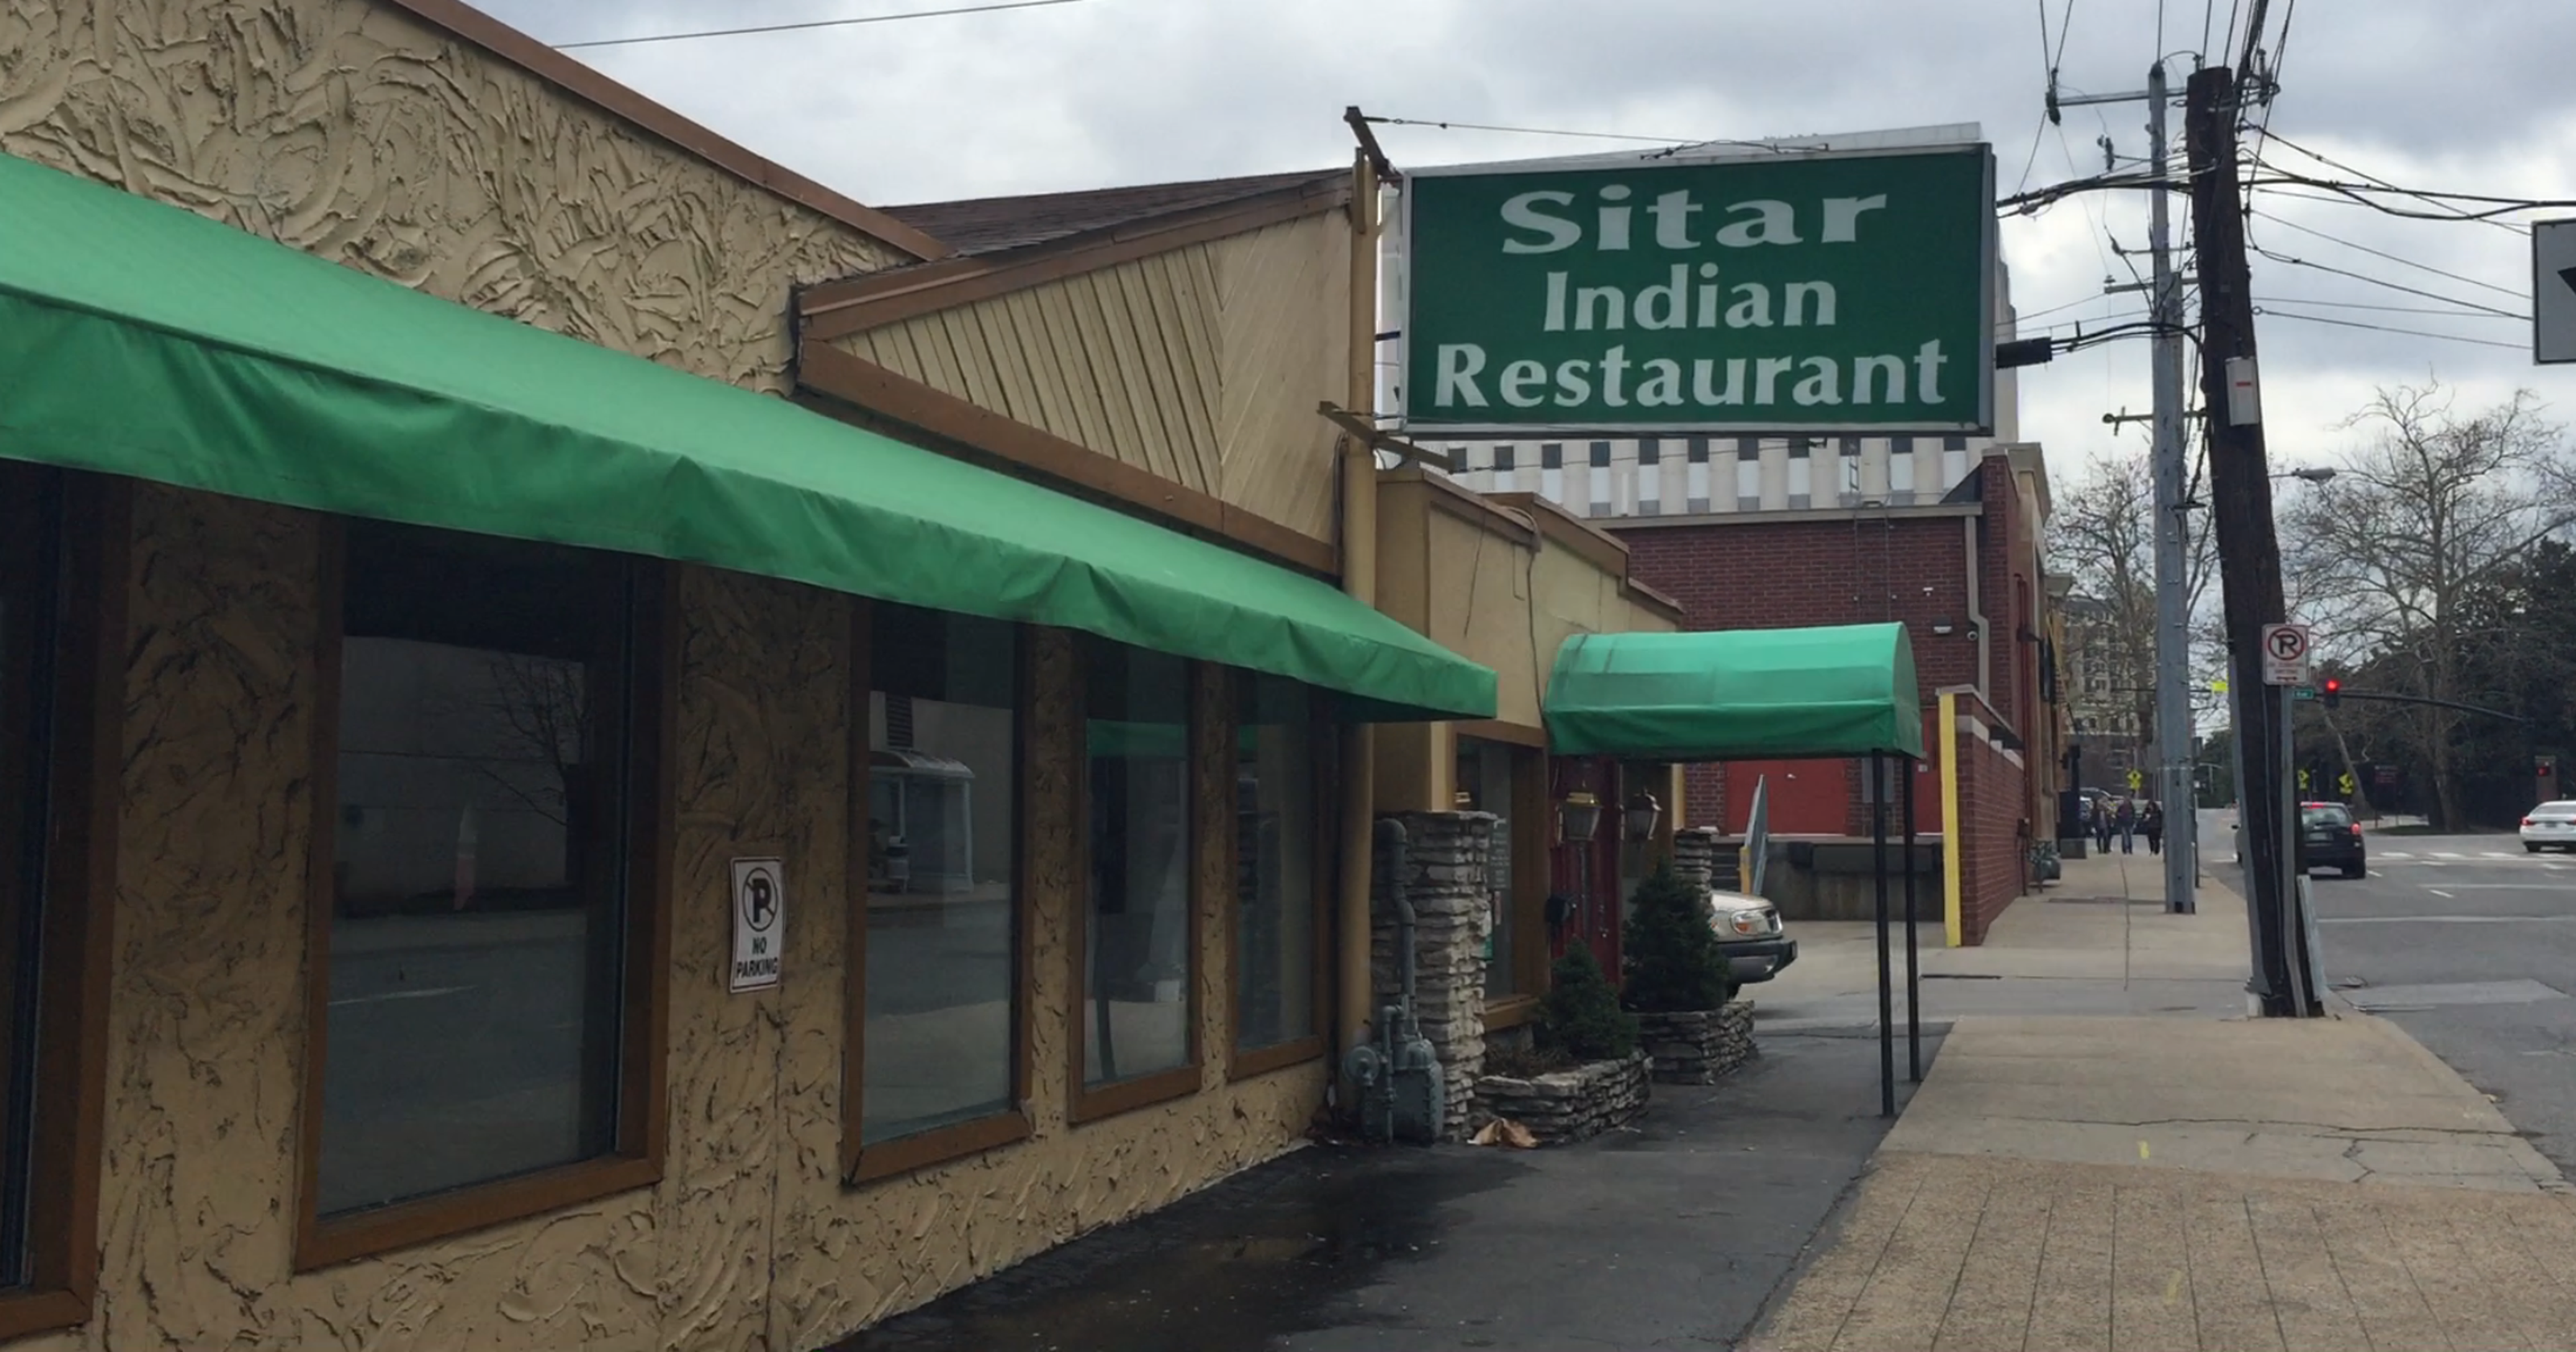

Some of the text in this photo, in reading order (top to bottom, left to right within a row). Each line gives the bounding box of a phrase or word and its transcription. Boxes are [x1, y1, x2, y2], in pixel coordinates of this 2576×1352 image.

[1500, 184, 1887, 254] Sitar
[1543, 262, 1837, 332] Indian
[1434, 338, 1948, 407] Restaurant
[737, 957, 778, 979] PARKING
[752, 936, 767, 955] NO
